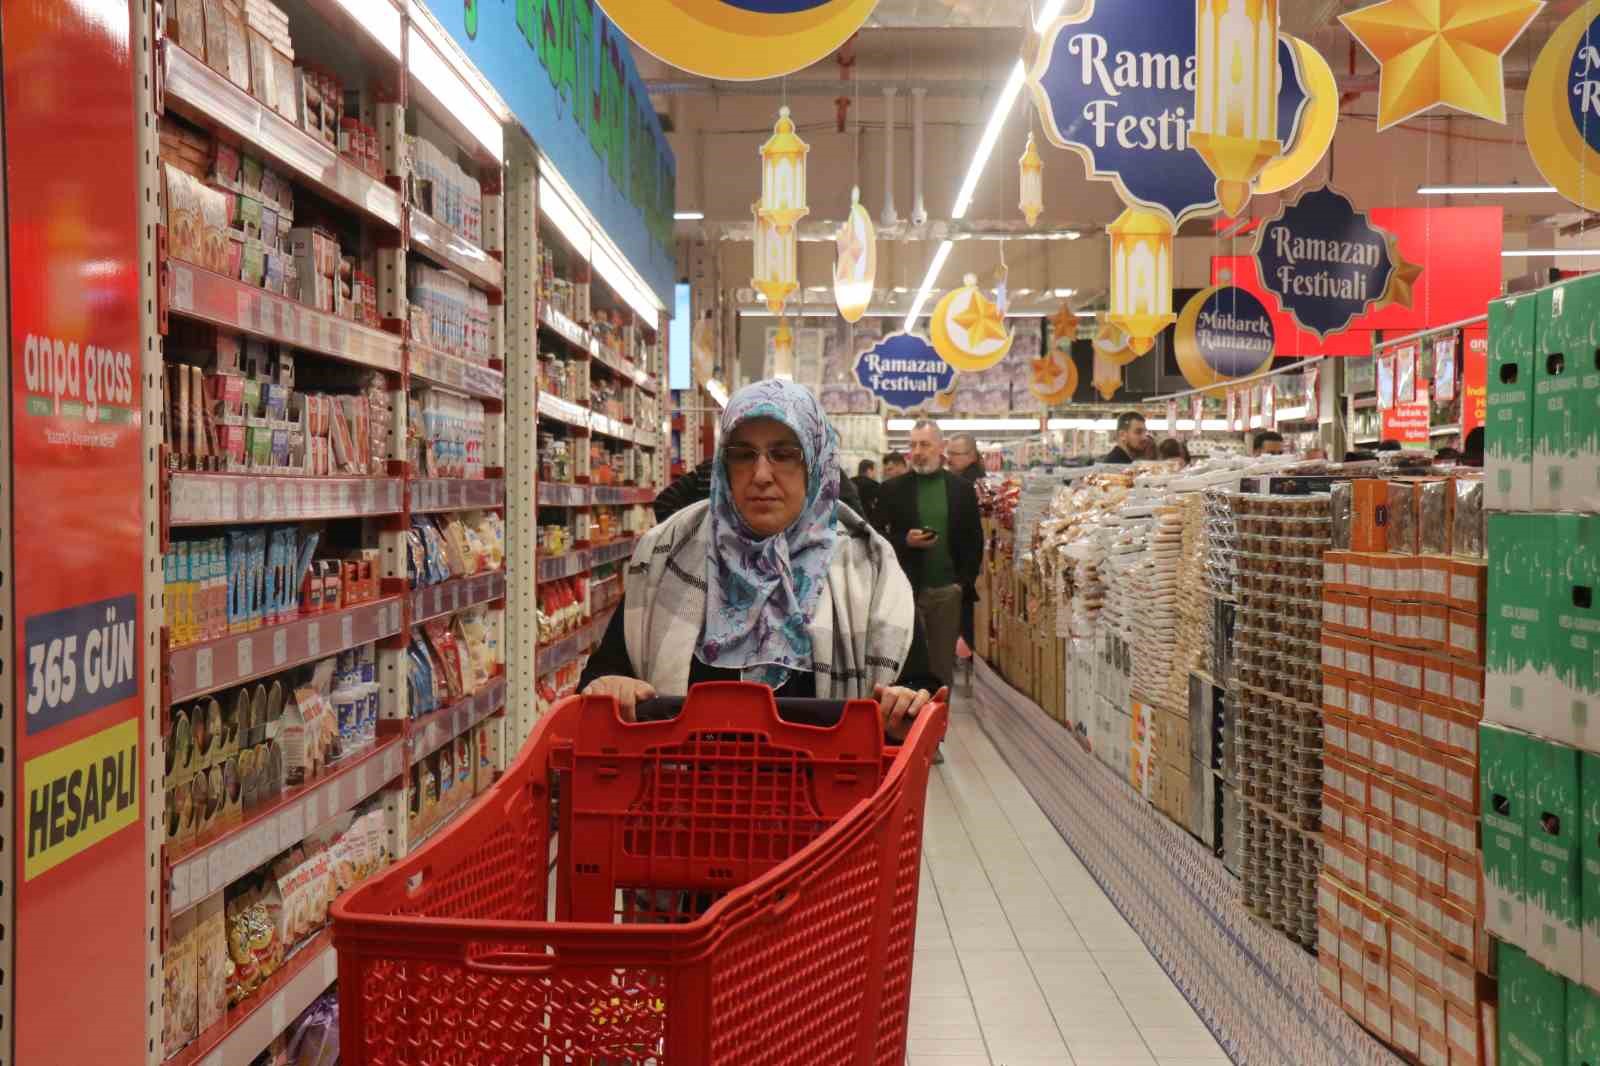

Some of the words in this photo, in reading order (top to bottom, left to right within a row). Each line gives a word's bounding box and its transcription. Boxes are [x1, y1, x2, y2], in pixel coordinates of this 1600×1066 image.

[1083, 99, 1195, 151] Festi
[1270, 226, 1380, 269] Ramazan
[1276, 265, 1367, 301] Festivali
[1197, 329, 1273, 352] Ramazan
[24, 333, 80, 415] anpa
[84, 344, 132, 423] gross
[864, 353, 948, 377] Ramazan
[869, 375, 937, 392] Festivali
[27, 636, 77, 715] 365
[84, 606, 135, 694] GÜN
[27, 745, 137, 859] HESAPLI
